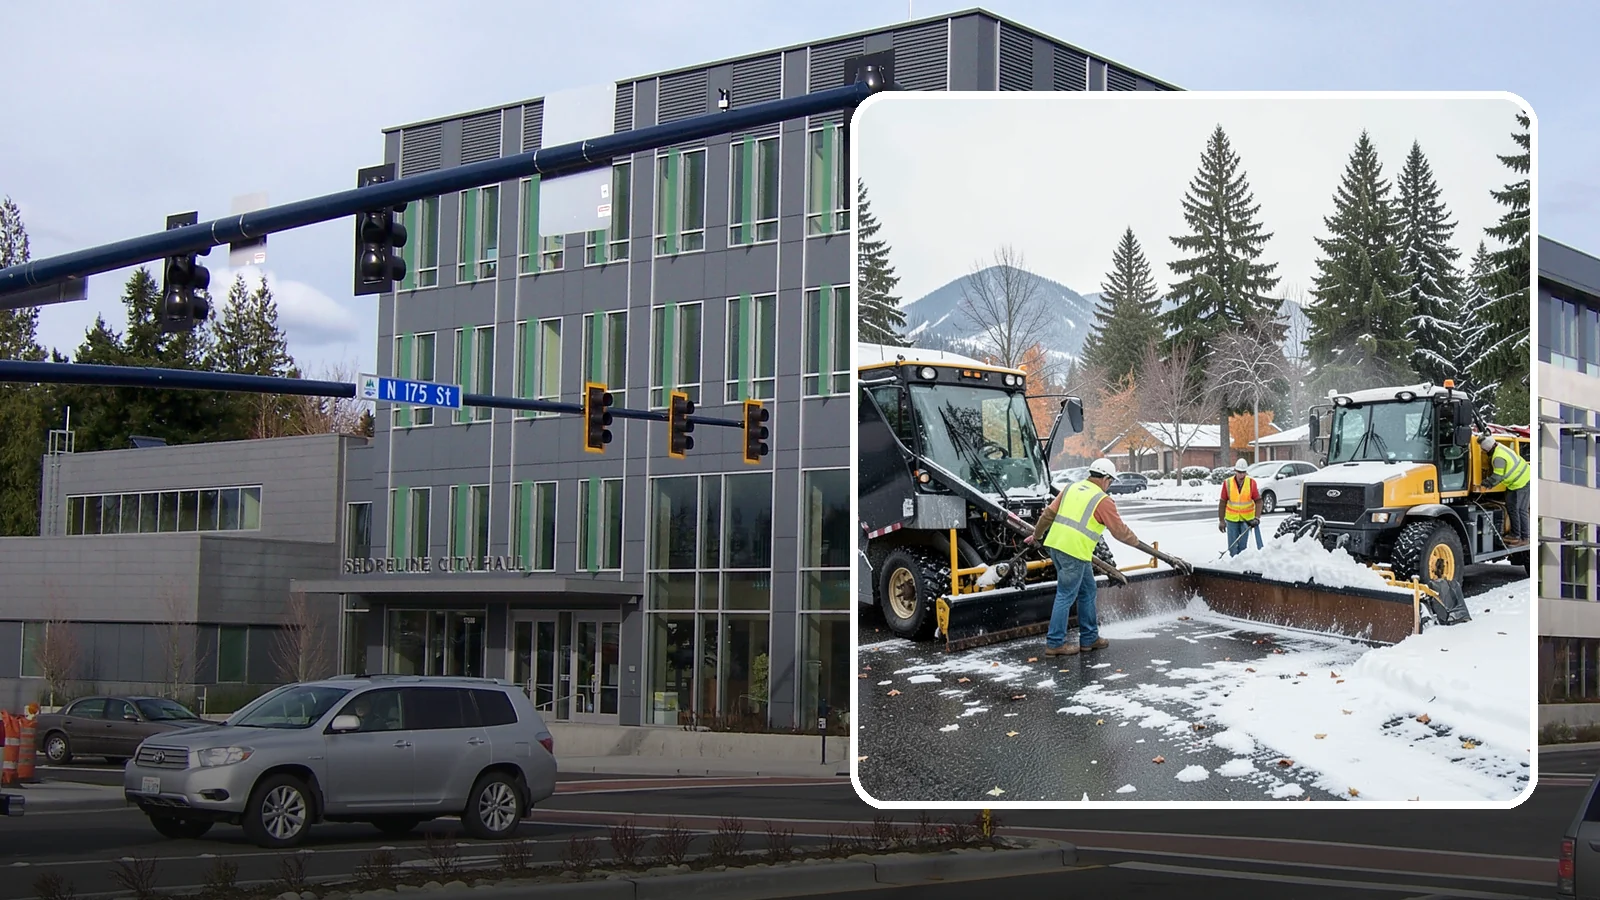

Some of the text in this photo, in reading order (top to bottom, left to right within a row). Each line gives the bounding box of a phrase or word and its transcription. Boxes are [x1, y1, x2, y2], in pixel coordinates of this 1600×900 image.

[387, 380, 451, 406] N 175 St
[343, 555, 525, 573] SHORELINE CITY HALL
